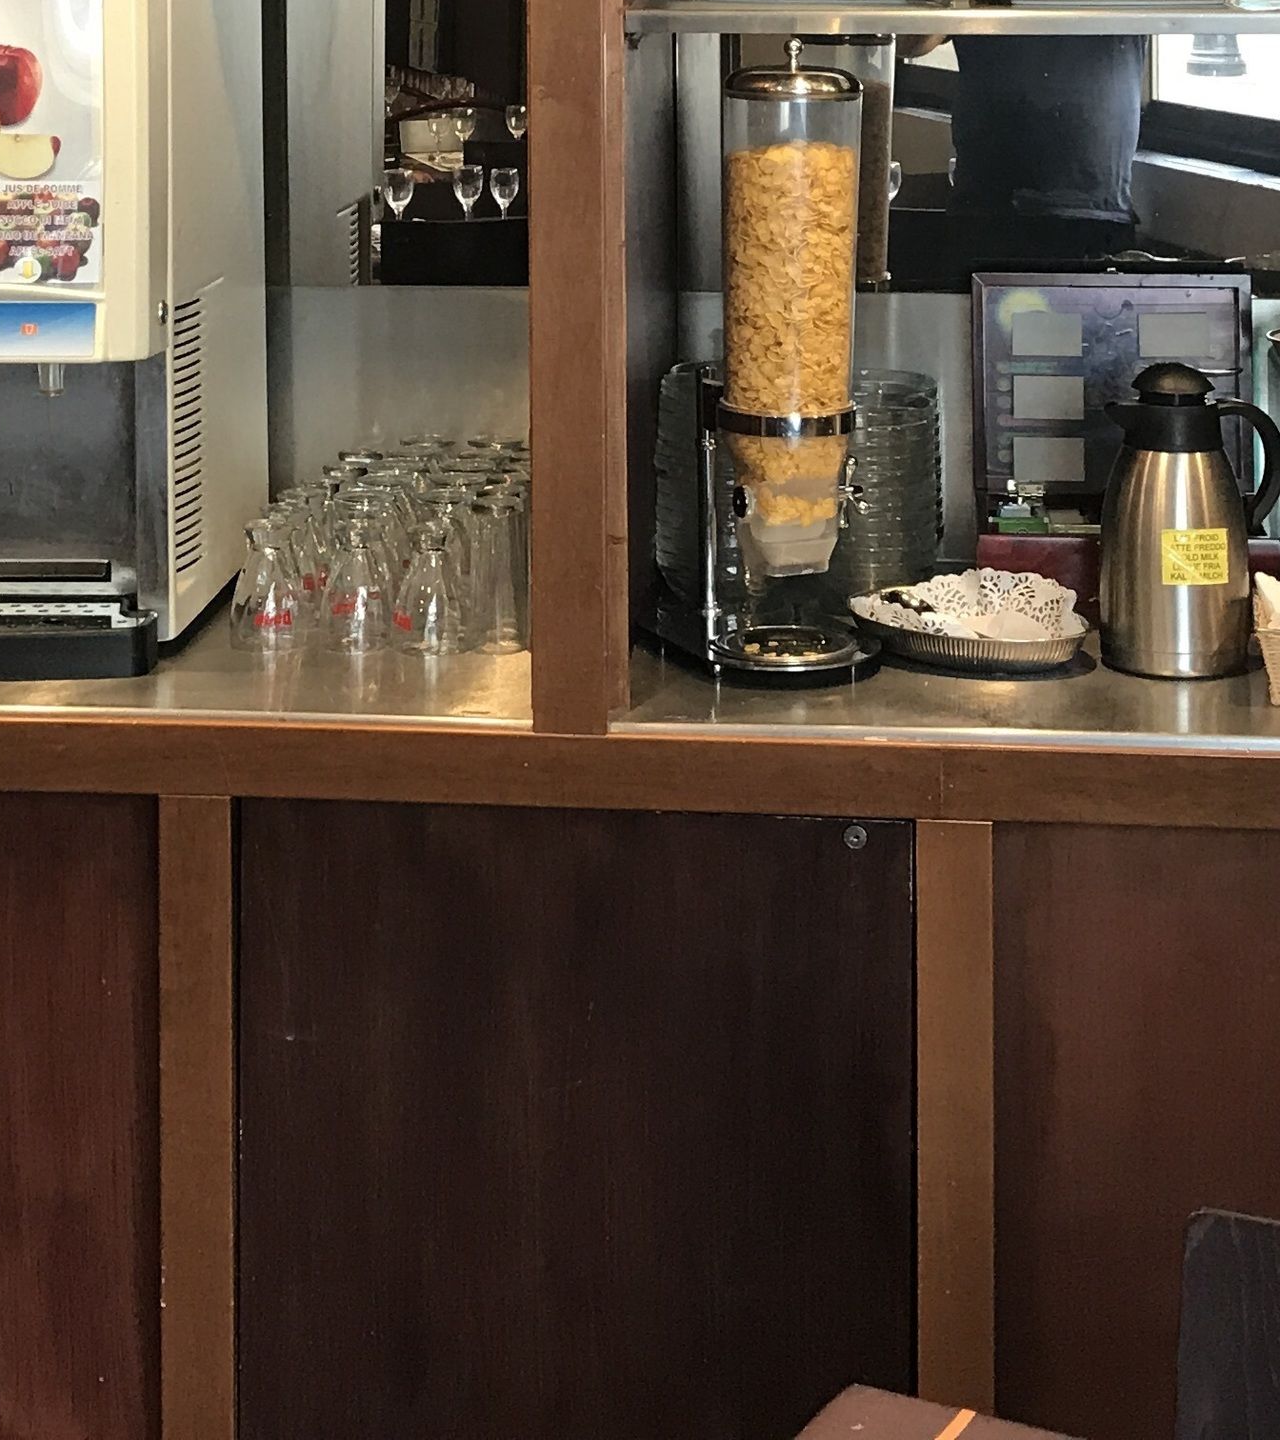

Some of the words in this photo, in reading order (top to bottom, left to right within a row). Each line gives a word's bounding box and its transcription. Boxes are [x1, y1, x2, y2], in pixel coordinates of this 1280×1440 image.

[1, 184, 23, 193] JUS
[26, 184, 40, 193] DE
[1200, 553, 1219, 561] MILK
